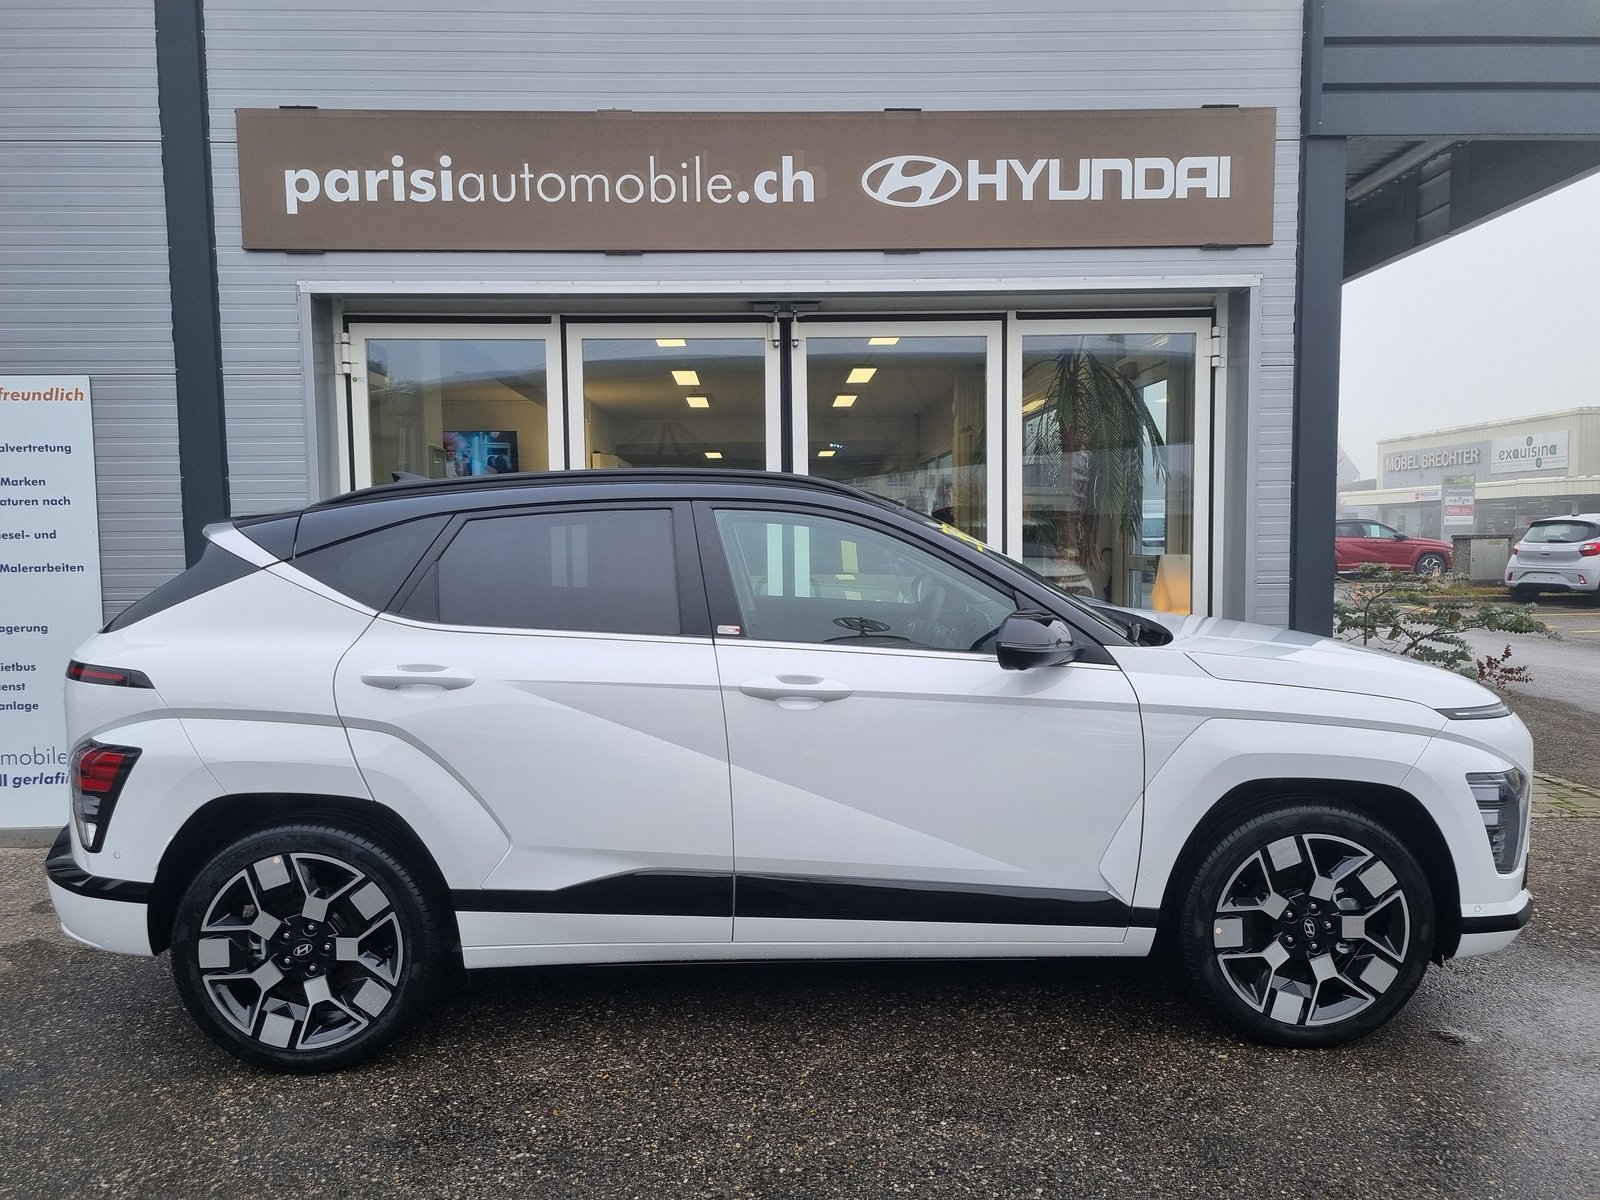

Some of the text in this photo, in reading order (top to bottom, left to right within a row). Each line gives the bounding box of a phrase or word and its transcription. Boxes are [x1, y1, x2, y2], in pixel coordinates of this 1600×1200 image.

[967, 155, 1231, 201] HYUNDAI
[284, 155, 815, 215] parisiautomobile.ch
[1421, 448, 1479, 468] BRECHTER
[0, 477, 46, 487] Marken
[0, 496, 71, 506] aturen nach
[34, 530, 57, 539] und
[0, 562, 84, 573] Malerarbeiten
[0, 625, 48, 635] agerung
[0, 662, 36, 672] ietbus
[0, 701, 39, 713] anlage
